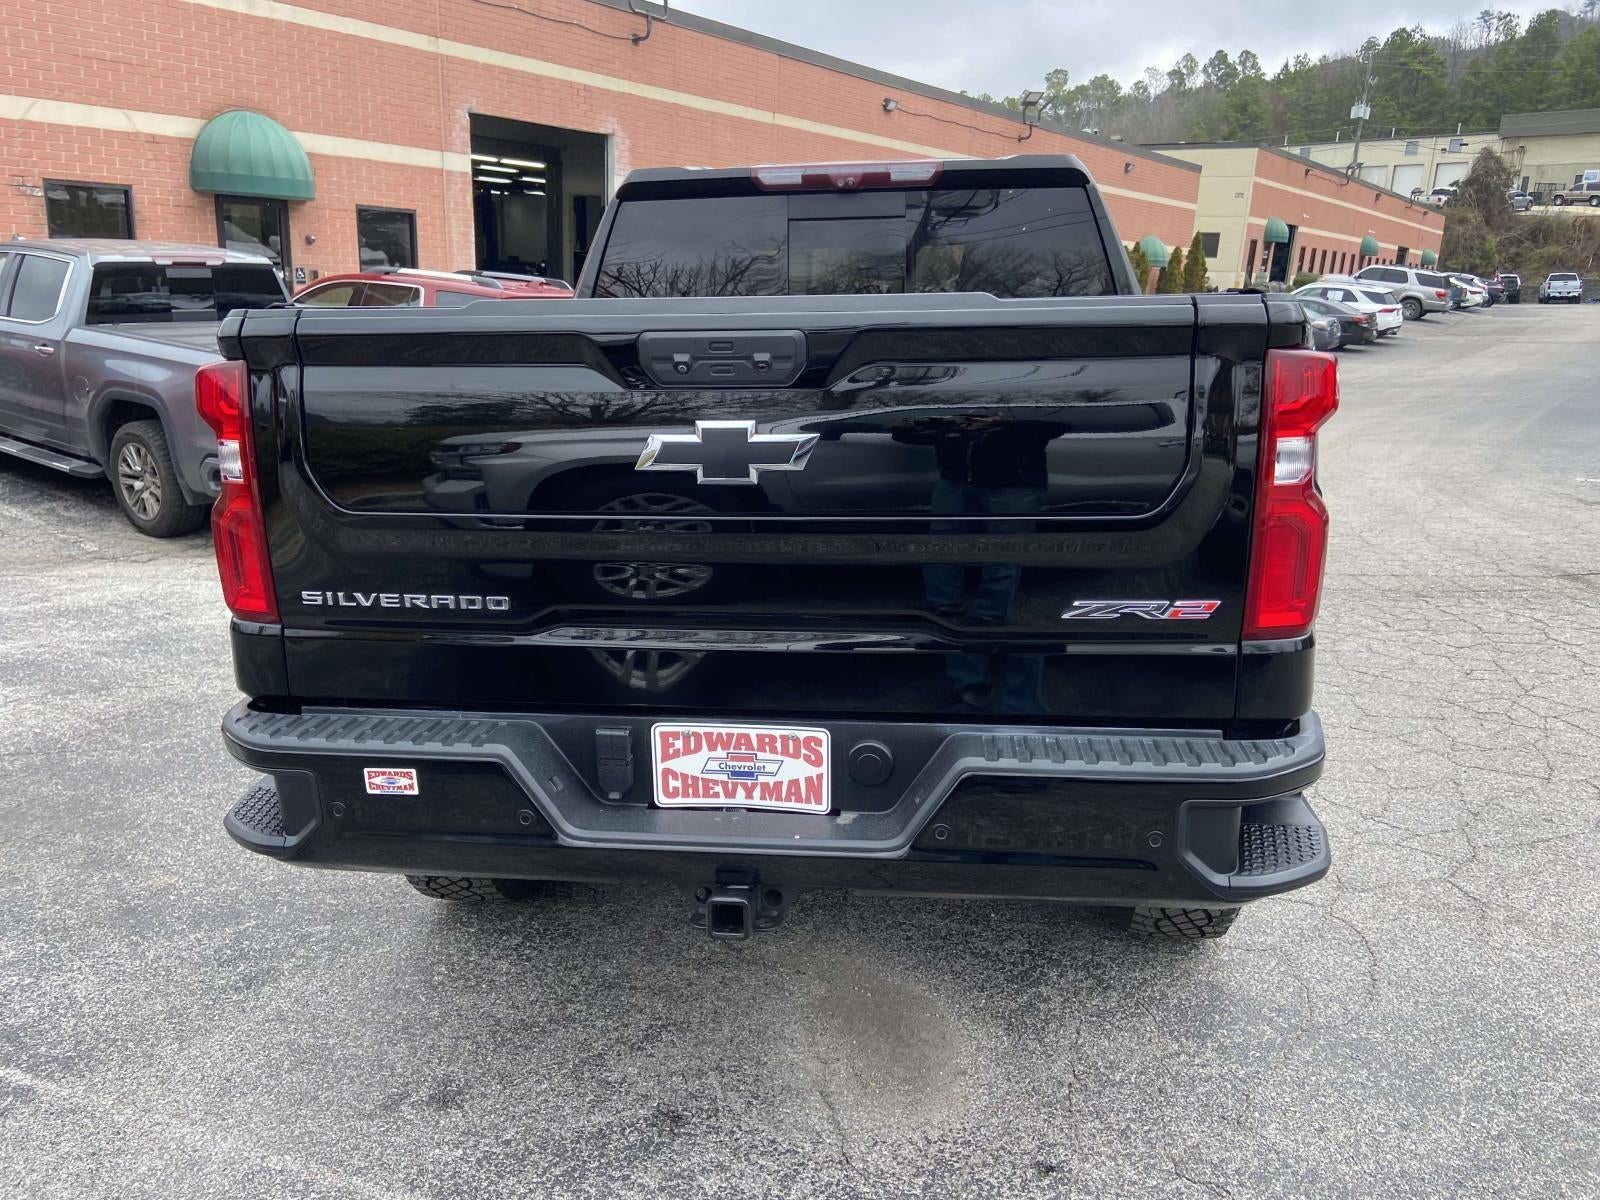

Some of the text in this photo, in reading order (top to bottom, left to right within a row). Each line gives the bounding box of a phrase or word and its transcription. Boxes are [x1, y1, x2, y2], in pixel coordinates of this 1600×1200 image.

[301, 591, 510, 610] SILVERADO
[1061, 600, 1222, 620] ZR2
[659, 730, 824, 768] EDWARDS
[367, 770, 414, 781] EDWARDS
[718, 762, 766, 772] Chevrolet
[368, 781, 415, 792] CHEVYMAN
[661, 767, 824, 806] CHEVYMAN
